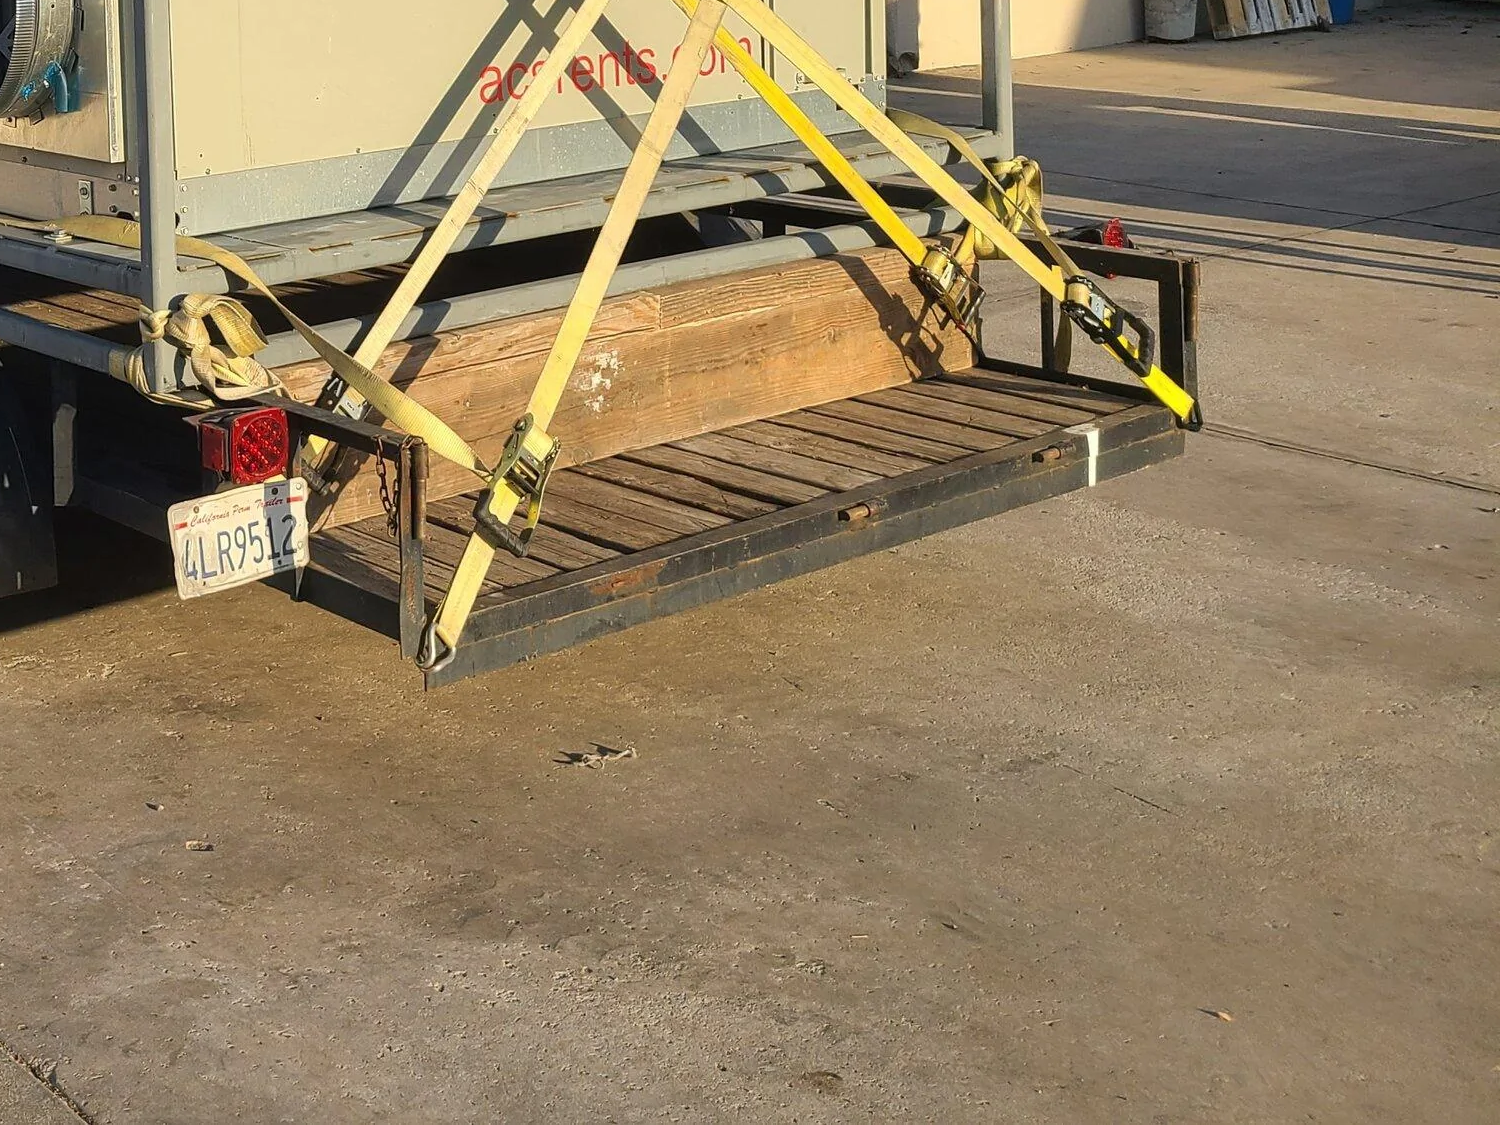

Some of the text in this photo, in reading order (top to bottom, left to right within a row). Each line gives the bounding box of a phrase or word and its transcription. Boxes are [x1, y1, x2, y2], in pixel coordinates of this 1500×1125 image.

[190, 496, 284, 528] California Perm Trailer
[183, 513, 298, 581] 4LR9512
